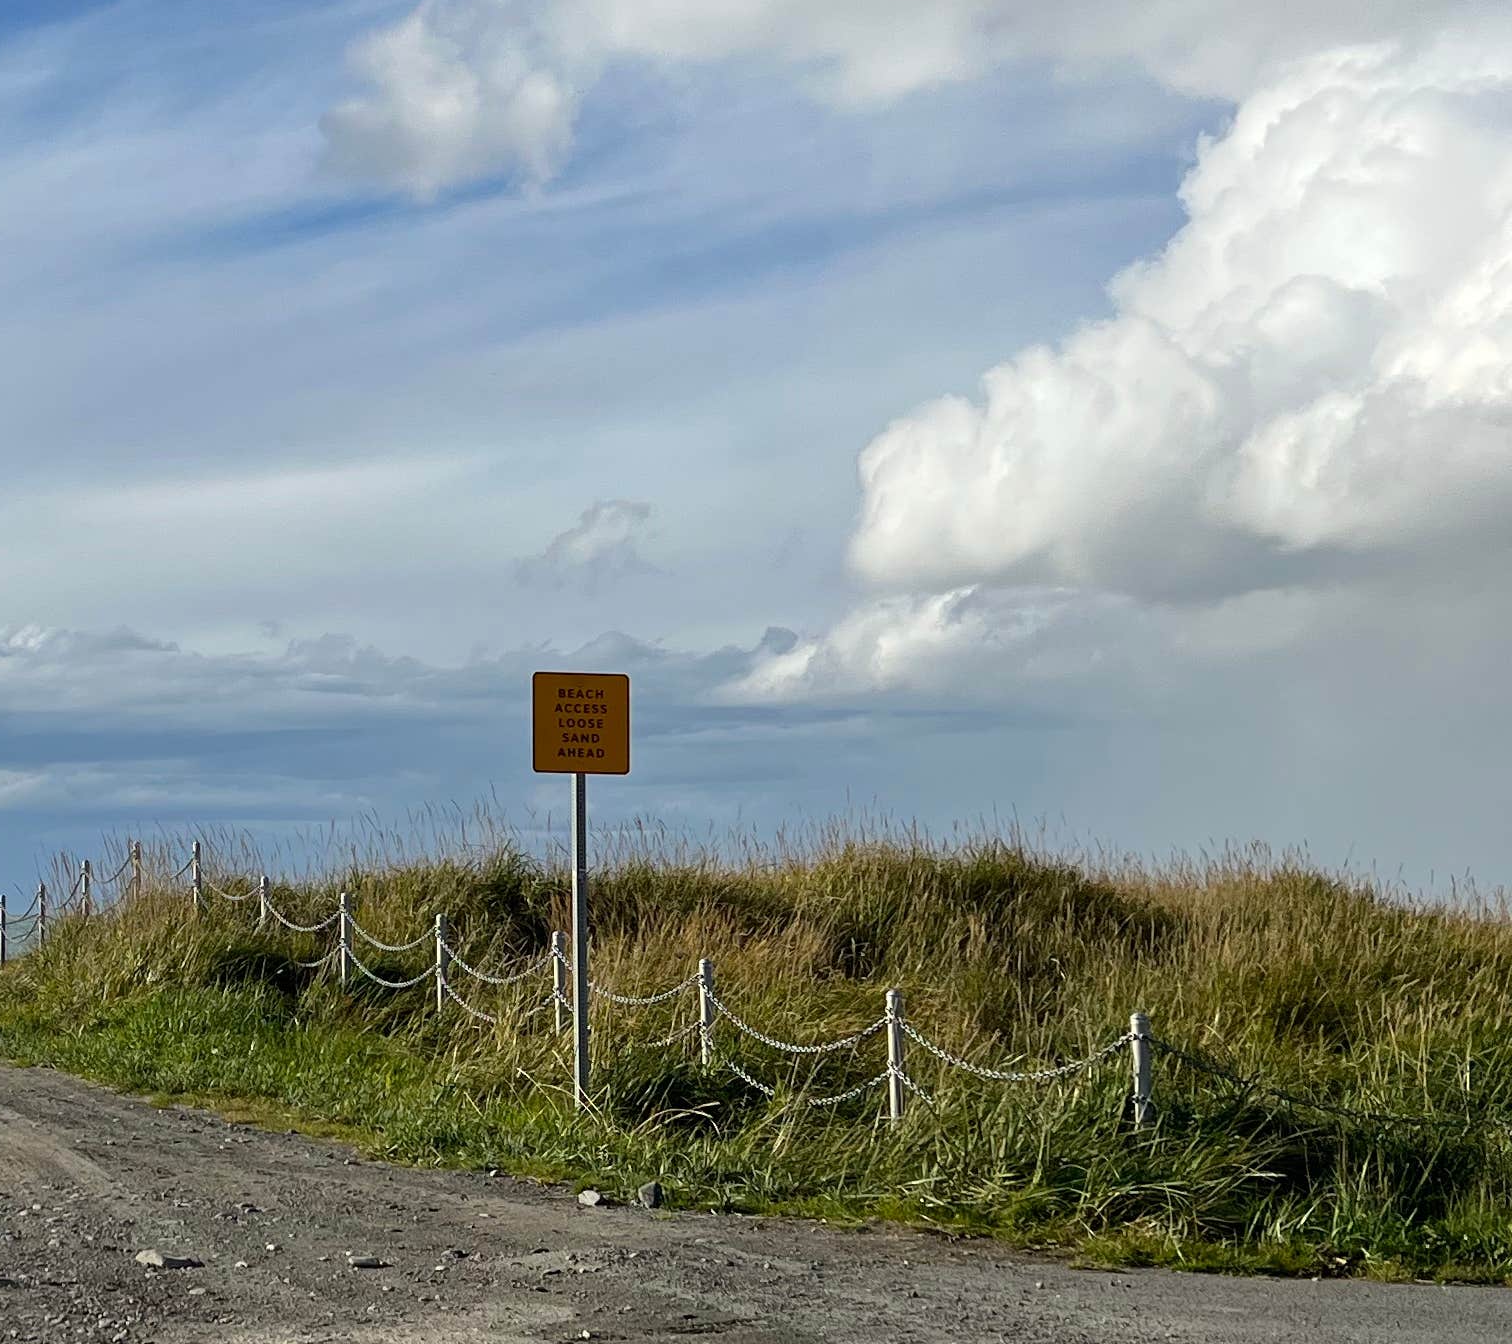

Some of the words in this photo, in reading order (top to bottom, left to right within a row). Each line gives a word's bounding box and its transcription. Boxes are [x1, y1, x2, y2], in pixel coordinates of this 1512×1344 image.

[558, 688, 605, 699] BEACH
[554, 703, 608, 714] ACCESS
[558, 718, 604, 729] LOOSE
[562, 732, 600, 744] SAND
[557, 747, 605, 758] AHEAD
